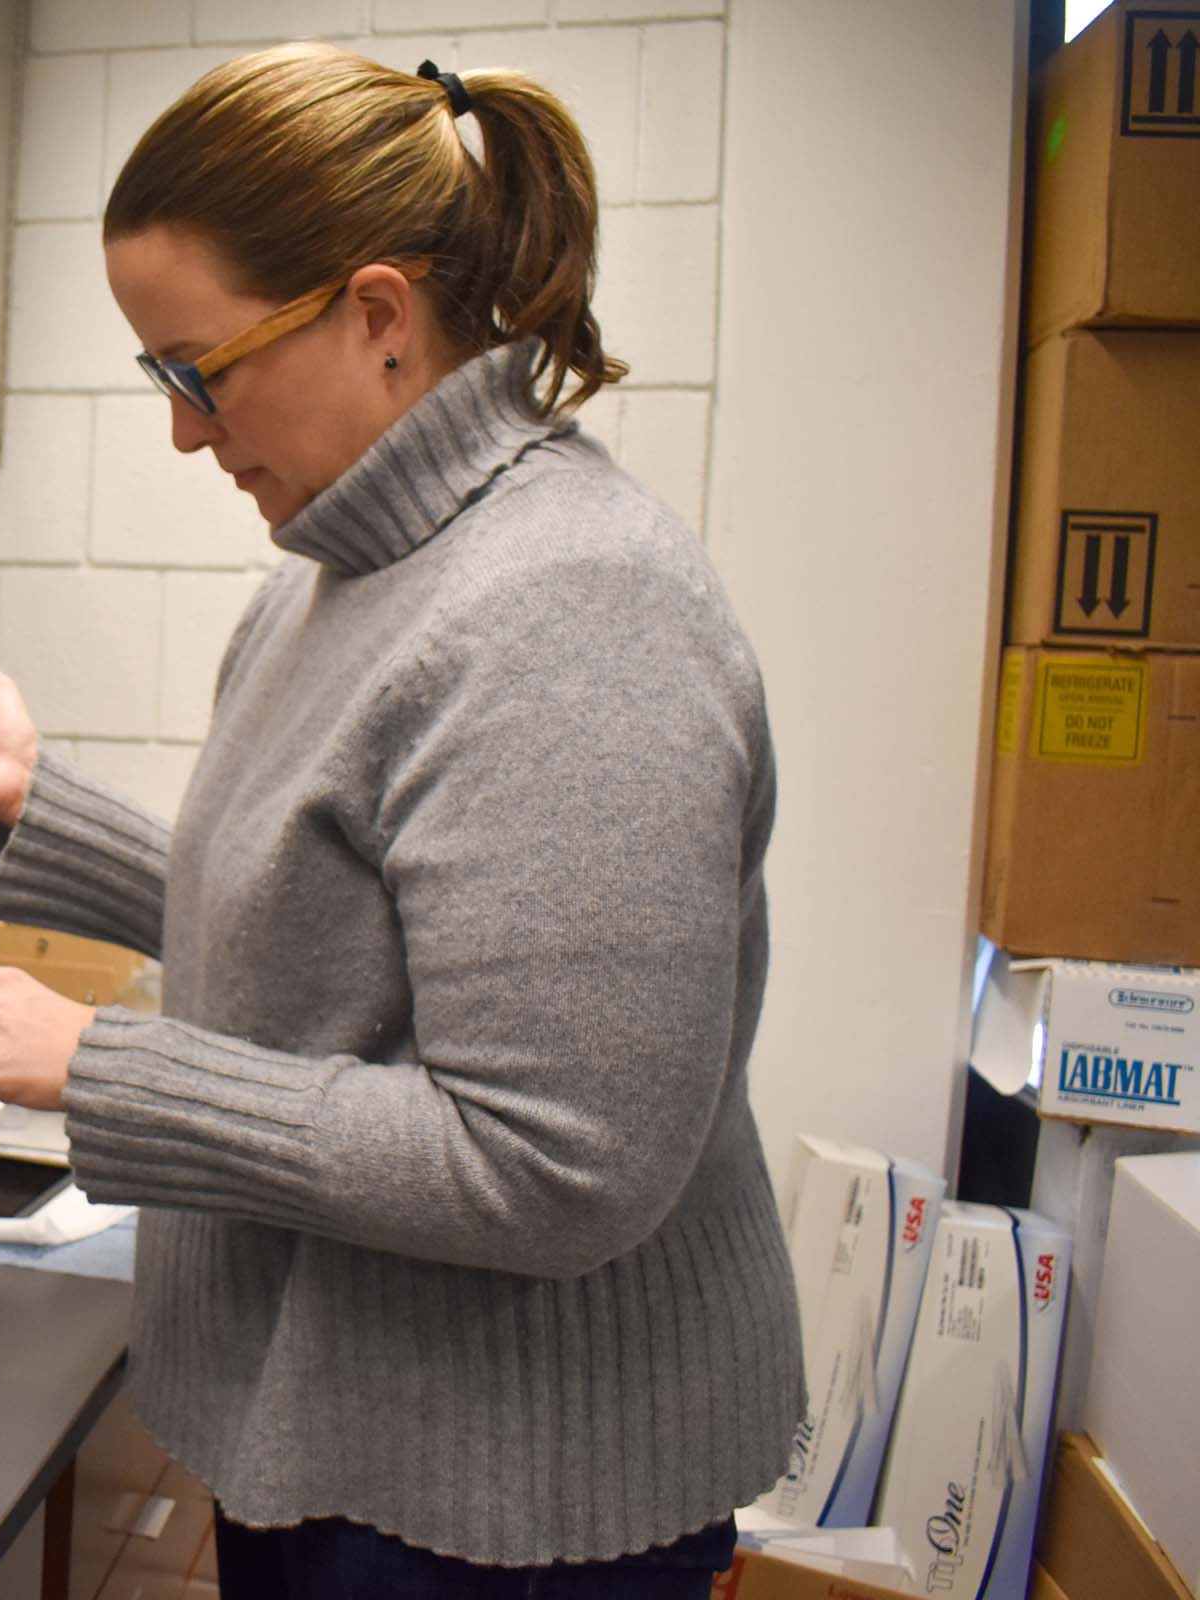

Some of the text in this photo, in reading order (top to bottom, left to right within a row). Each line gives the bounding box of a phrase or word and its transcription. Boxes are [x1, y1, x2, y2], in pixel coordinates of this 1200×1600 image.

[1050, 674, 1137, 694] REFRIGERATE
[1064, 714, 1114, 731] DO NOT
[1064, 731, 1111, 748] FREEZE
[1058, 1050, 1182, 1106] LABMAT
[902, 1196, 928, 1244] USA
[1034, 1253, 1056, 1303] USA
[926, 1481, 966, 1593] TipOne
